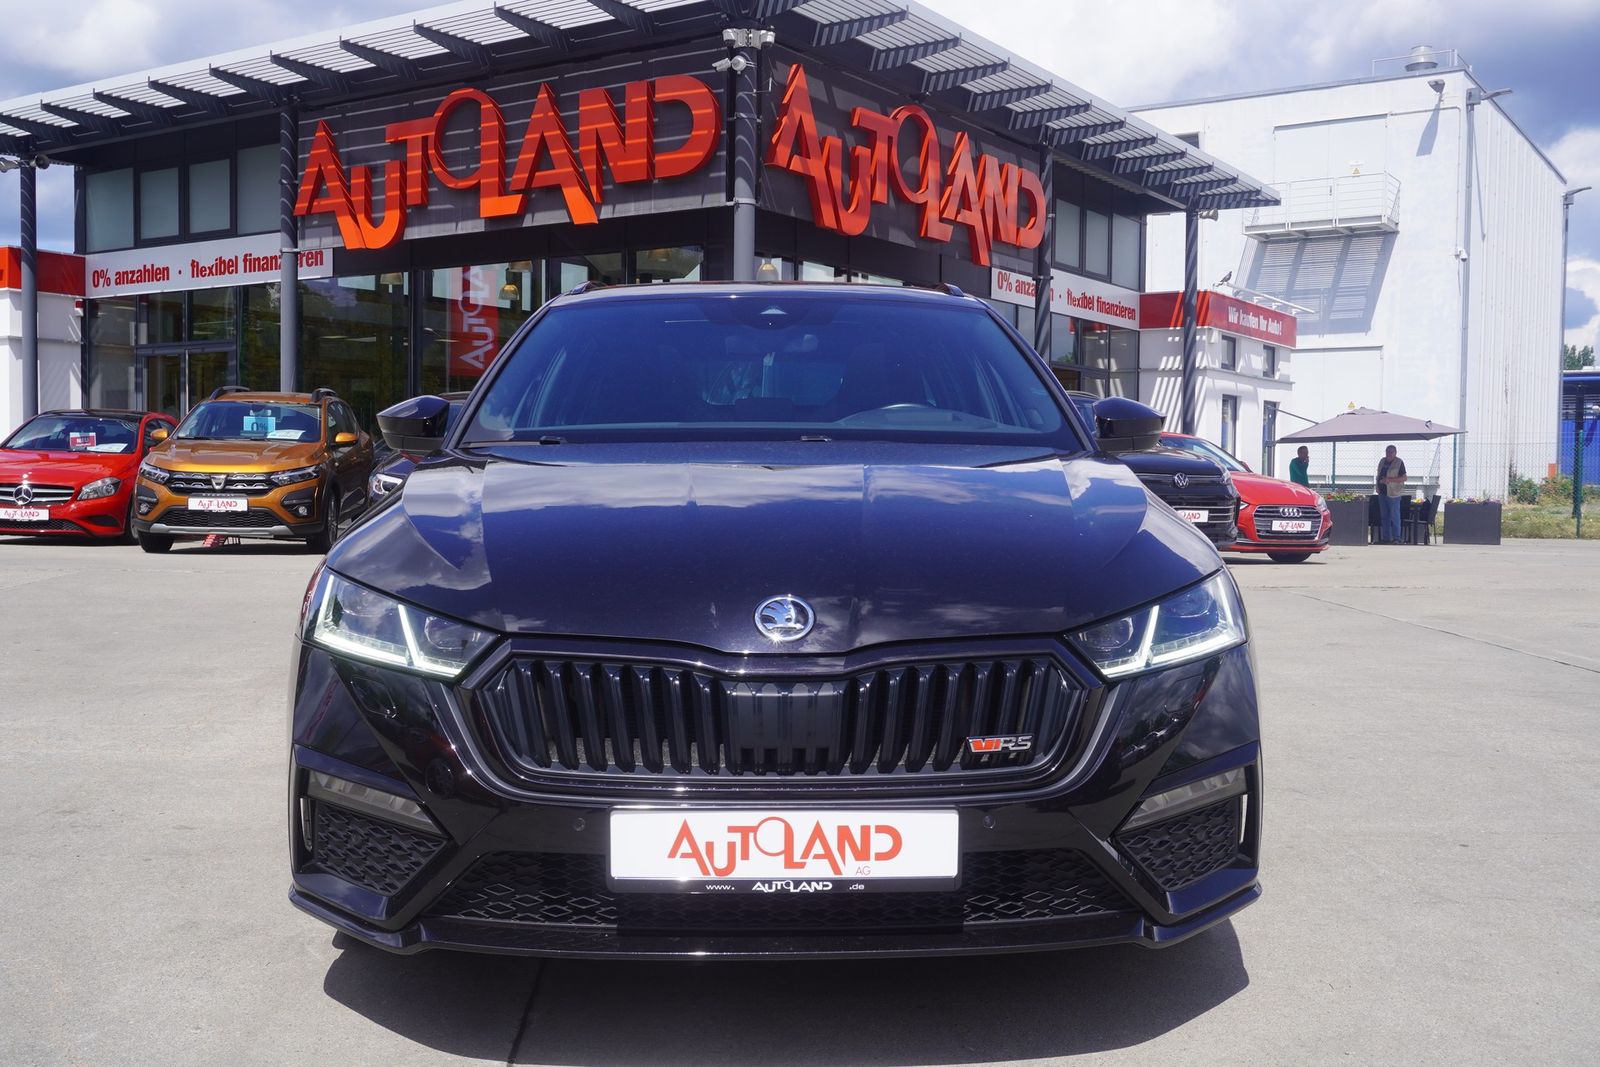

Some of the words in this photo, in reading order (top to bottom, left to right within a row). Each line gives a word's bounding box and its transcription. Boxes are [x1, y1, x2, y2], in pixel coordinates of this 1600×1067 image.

[293, 75, 721, 249] AUTOLAND
[764, 64, 1046, 267] AUTOLAND
[92, 269, 111, 288] 0%
[114, 263, 170, 286] anzahlen
[190, 255, 239, 279] flexibel
[243, 249, 324, 275] finanren
[997, 271, 1012, 292] 0%
[1015, 278, 1054, 302] anzan
[1066, 288, 1095, 311] flexibel
[1096, 296, 1136, 321] finanzieren
[1228, 306, 1239, 324] Wir
[667, 817, 903, 877] AUTOLAND
[751, 880, 833, 893] AUTOLAND
[855, 865, 872, 876] AG
